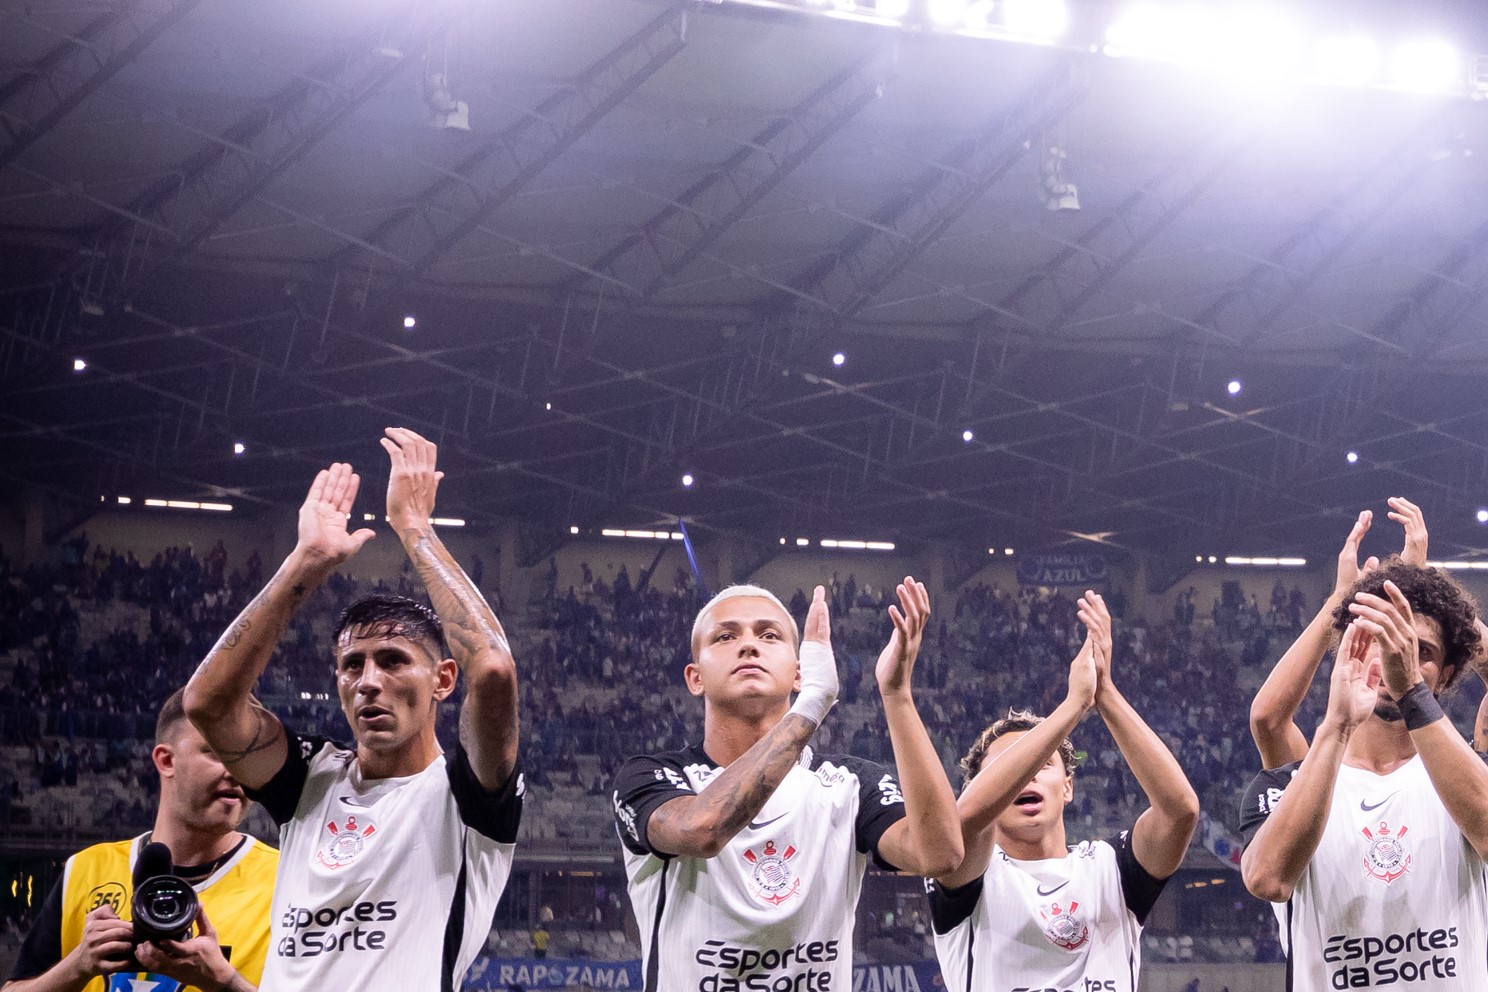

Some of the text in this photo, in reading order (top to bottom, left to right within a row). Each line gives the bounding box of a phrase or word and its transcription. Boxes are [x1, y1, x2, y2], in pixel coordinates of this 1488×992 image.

[300, 926, 386, 957] Sorte
[695, 939, 839, 977] Esportes
[1323, 926, 1459, 965] Esportes
[1331, 954, 1457, 991] da Sorte
